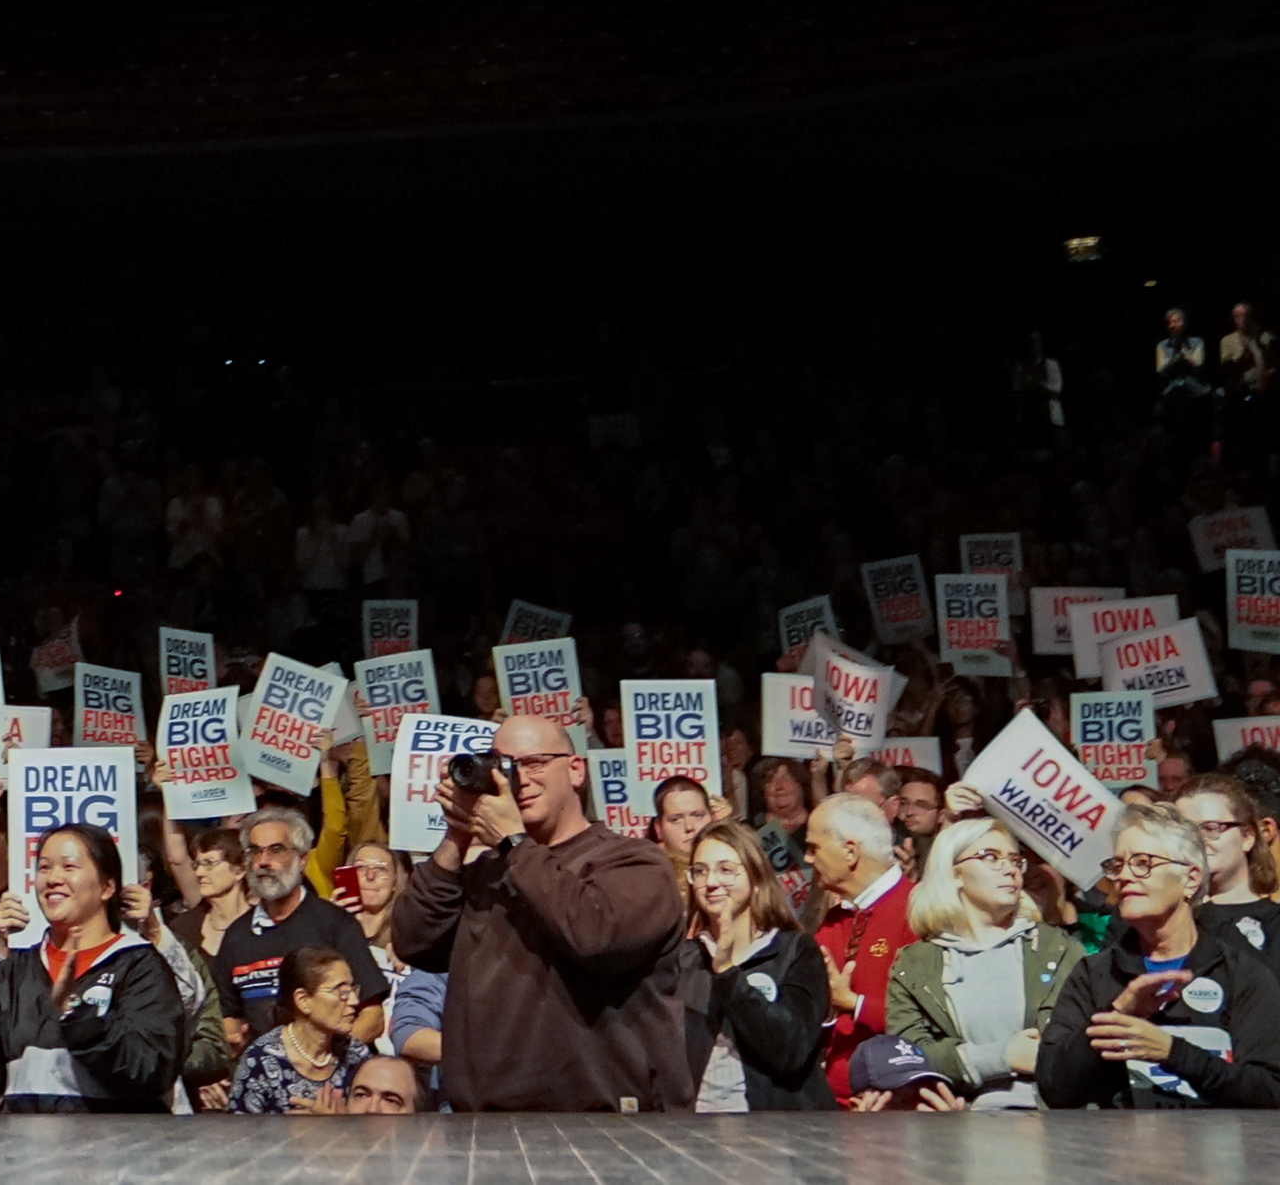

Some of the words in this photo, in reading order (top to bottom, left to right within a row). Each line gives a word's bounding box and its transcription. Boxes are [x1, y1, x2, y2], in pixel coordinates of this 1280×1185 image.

[1237, 560, 1280, 573] DREA
[946, 599, 998, 619] BIG
[1237, 596, 1280, 611] FIGH
[371, 622, 409, 639] BIG
[1093, 608, 1156, 635] IOWA
[505, 650, 565, 672] DREAM
[1117, 635, 1180, 670] IOWA
[167, 655, 208, 679] BIG
[366, 661, 424, 685] DREAM
[84, 674, 132, 694] DREAM
[271, 667, 335, 701] DREAM
[508, 668, 568, 696] BIG
[826, 662, 878, 704] IOWA
[1123, 667, 1187, 691] WARREN
[85, 690, 134, 713] BIG
[263, 684, 326, 724] BIG
[367, 680, 428, 708] BIG
[511, 692, 571, 716] FIGHT
[634, 693, 704, 711] DREAM
[791, 687, 814, 711] IO
[84, 710, 135, 731] FIGHT
[170, 698, 227, 720] DREAM
[371, 703, 430, 728] FIG
[1082, 702, 1142, 719] DREAM
[168, 719, 228, 746] BIG
[254, 707, 317, 743] FIGHT
[375, 727, 400, 744] HA
[635, 714, 706, 740] BIG
[791, 720, 835, 741] WARR
[1082, 720, 1143, 743] BIG
[83, 731, 138, 744] HARD
[250, 728, 311, 760] HARD
[411, 733, 492, 753] BIG
[1243, 728, 1280, 749] IOW
[168, 745, 231, 769] FIGHT
[636, 743, 707, 764] FIGHT
[1081, 744, 1145, 765] FIGHT
[25, 766, 117, 792] DREAM
[171, 769, 238, 785] HARD
[409, 755, 449, 780] FIG
[639, 768, 708, 782] HARD
[407, 786, 439, 803] HA
[1021, 748, 1107, 831] IOWA
[25, 795, 118, 833] BIG
[999, 779, 1084, 852] WARREN
[1043, 799, 1061, 815] FOR
